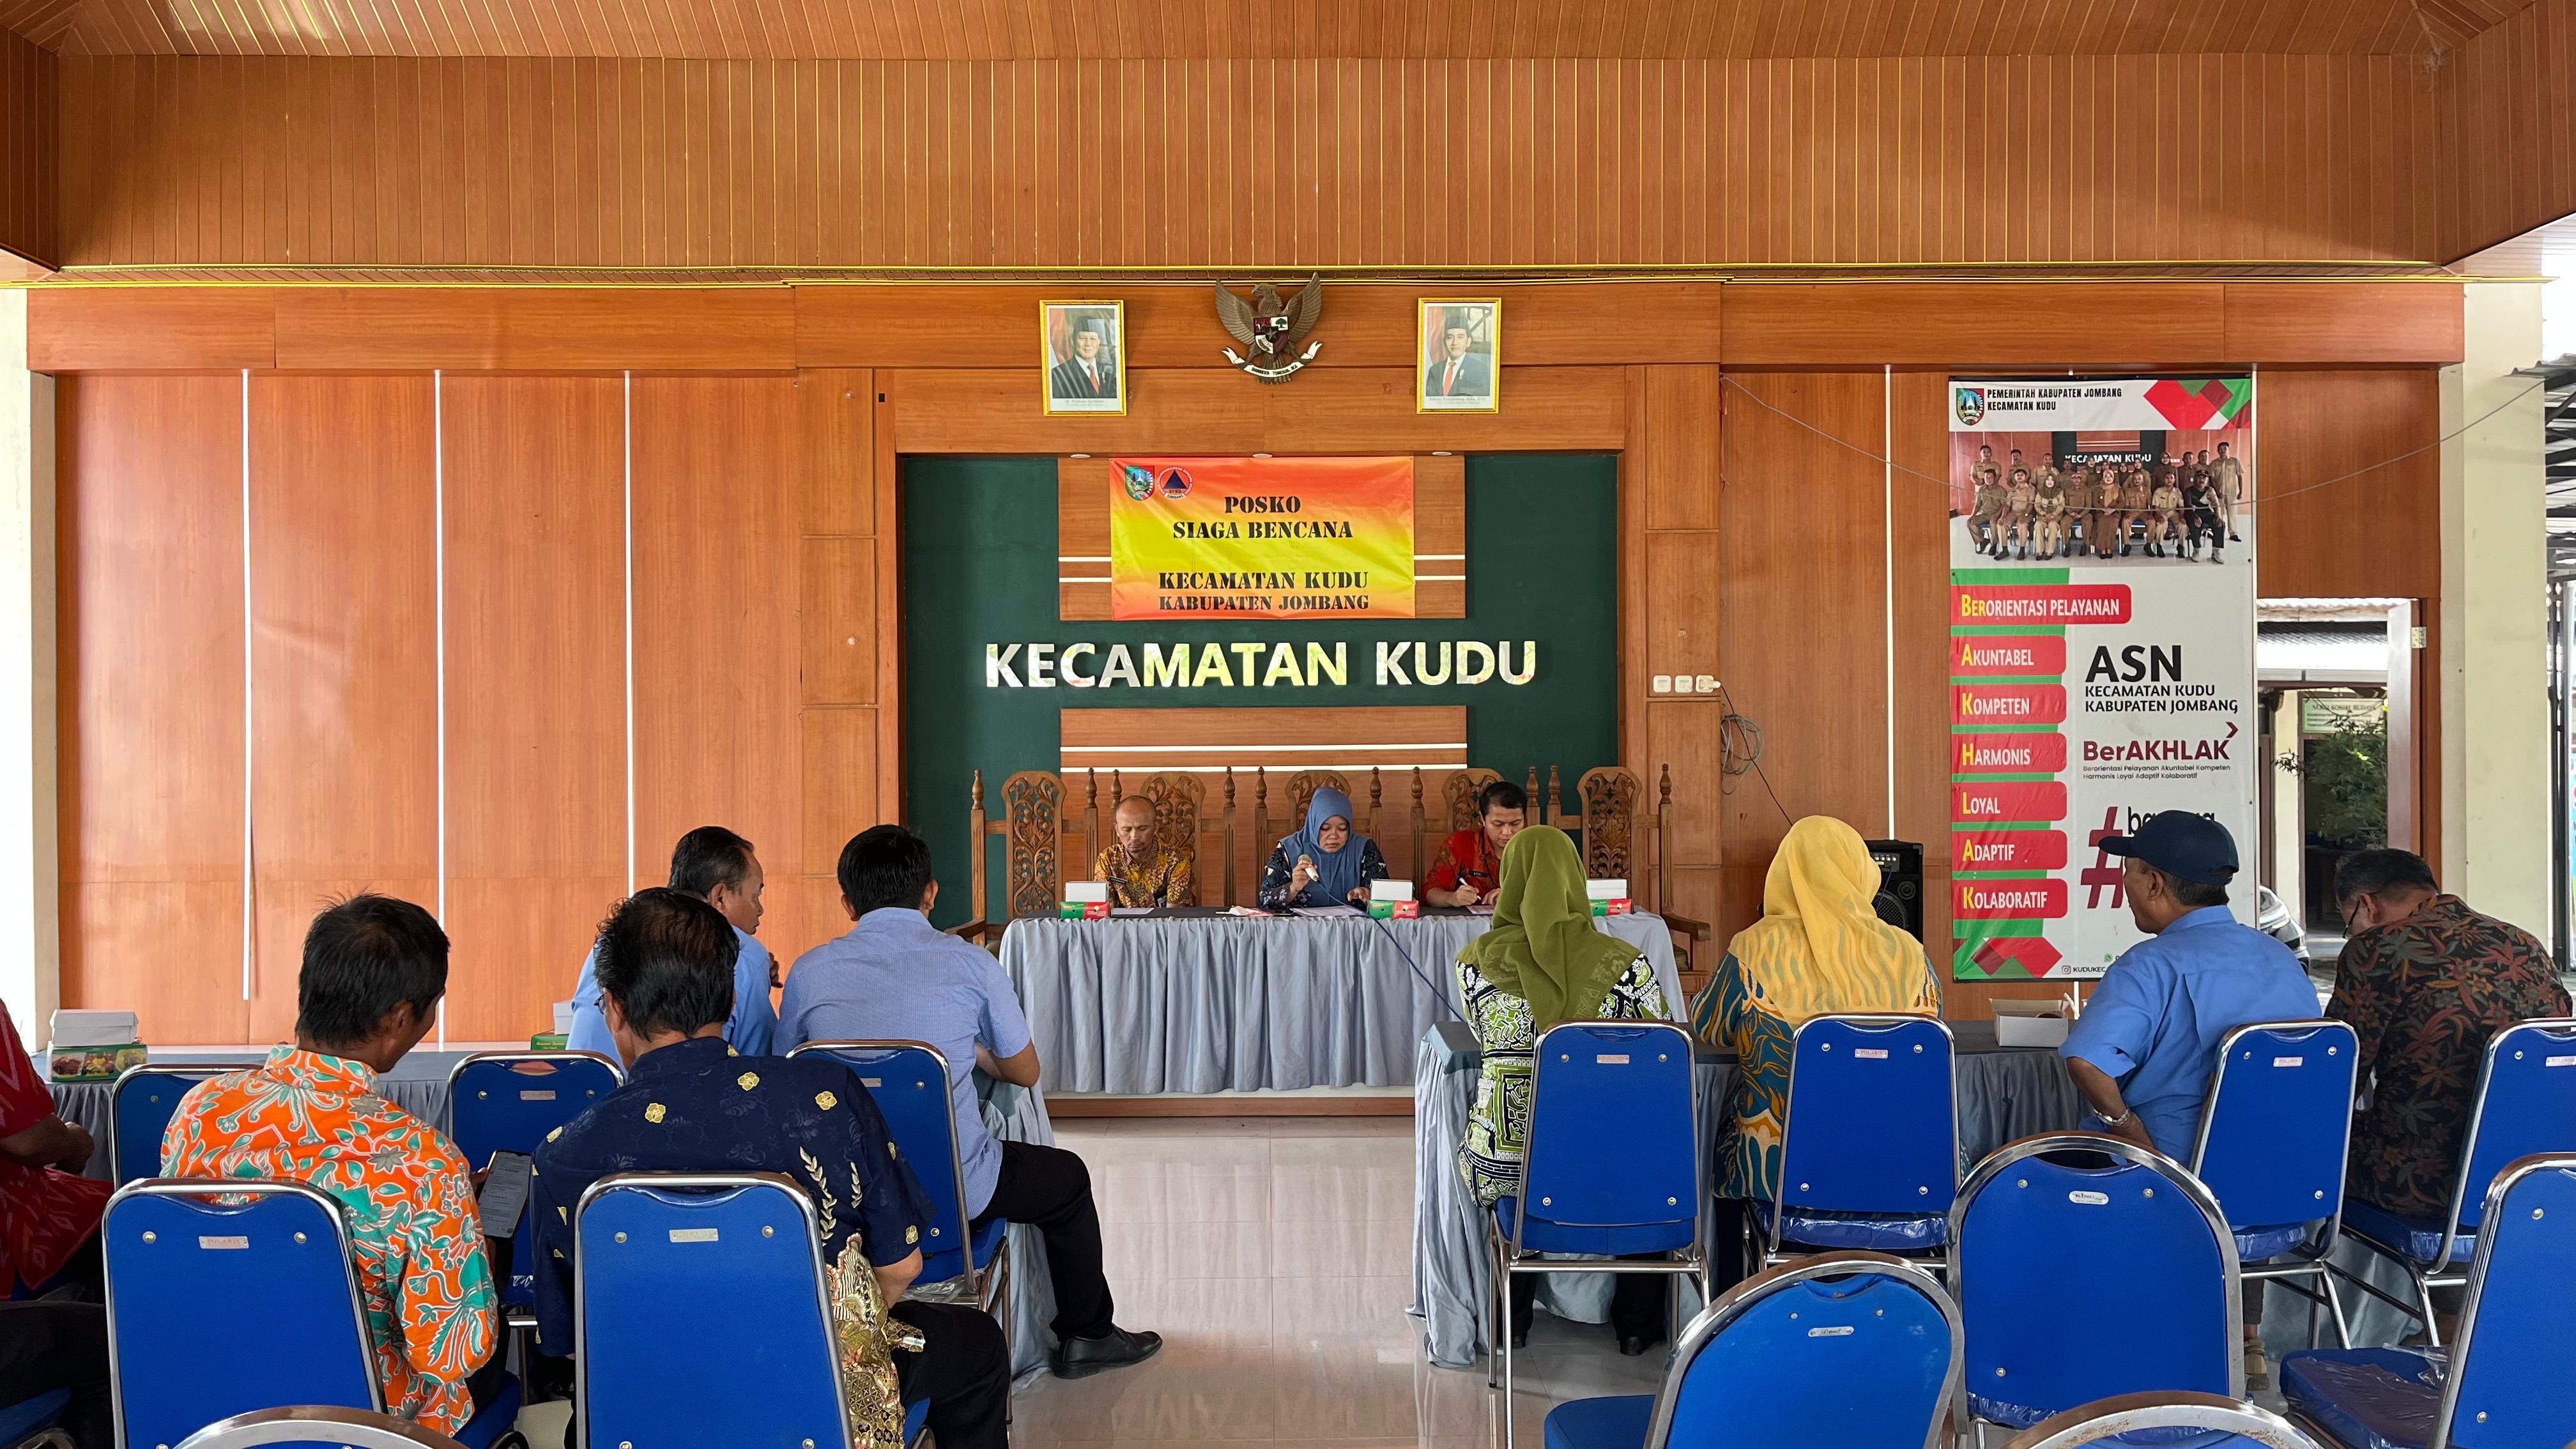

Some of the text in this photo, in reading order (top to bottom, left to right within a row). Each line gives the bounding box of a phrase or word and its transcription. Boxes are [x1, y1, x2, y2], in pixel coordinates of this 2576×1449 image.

[1987, 388, 2122, 399] PEMERINTAH KABUPATEN JOMBANG
[1987, 401, 2056, 411] KECAMATAN KUDU
[1225, 496, 1301, 514] POSKO
[1173, 521, 1354, 539] SIAGA BENCANA
[1159, 572, 1368, 590] KECAMATAN KUDU
[1159, 595, 1369, 611] KABUPATEN JOMBANG
[1961, 594, 2119, 617] BERORIENTASI PELAYANAN
[986, 641, 1536, 687] KECAMATAN KUDU
[1961, 643, 2034, 666] AKUNTABEL
[2085, 645, 2182, 683] ASN
[2085, 684, 2215, 697] KECAMATAN KUDU
[1962, 693, 2030, 716] KOMPETEN
[2085, 700, 2238, 715] KABUPATEN JOMBANG
[1962, 743, 2030, 766] HARMONIS
[2083, 739, 2230, 761] BerAKHLAK
[2124, 765, 2159, 773] Pelayanan
[1963, 792, 2001, 815] LOYAL
[1962, 839, 2015, 862] ADAPTIF
[1963, 887, 2048, 909] KOLABORATIF
